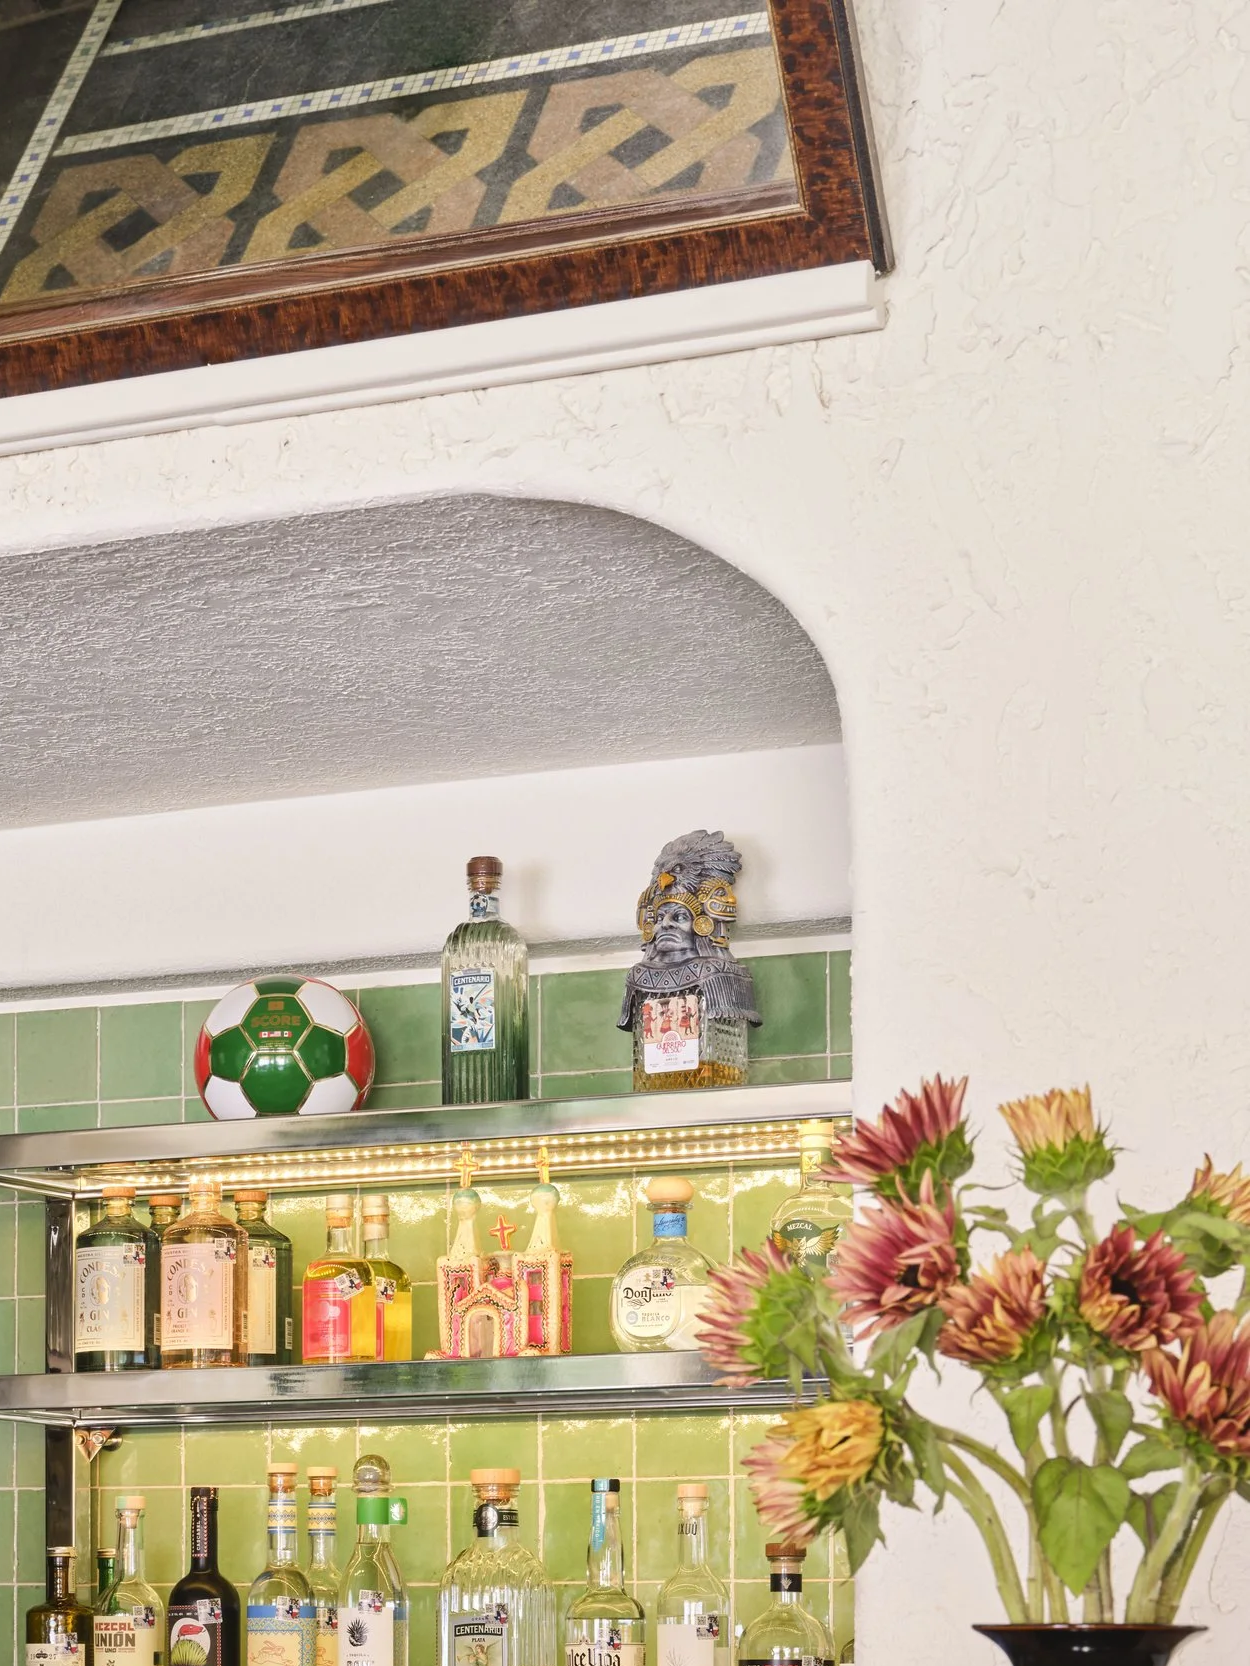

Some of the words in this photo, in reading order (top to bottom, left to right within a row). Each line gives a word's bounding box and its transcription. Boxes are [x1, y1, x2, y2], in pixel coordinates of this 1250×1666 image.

[454, 975, 491, 986] CENTENARIO
[251, 1014, 301, 1028] SCORE
[786, 1222, 813, 1231] MEZCAL
[623, 1286, 647, 1300] Don
[90, 1309, 110, 1321] GIN
[177, 1308, 198, 1320] GIN
[455, 1624, 502, 1635] CENTENARIO
